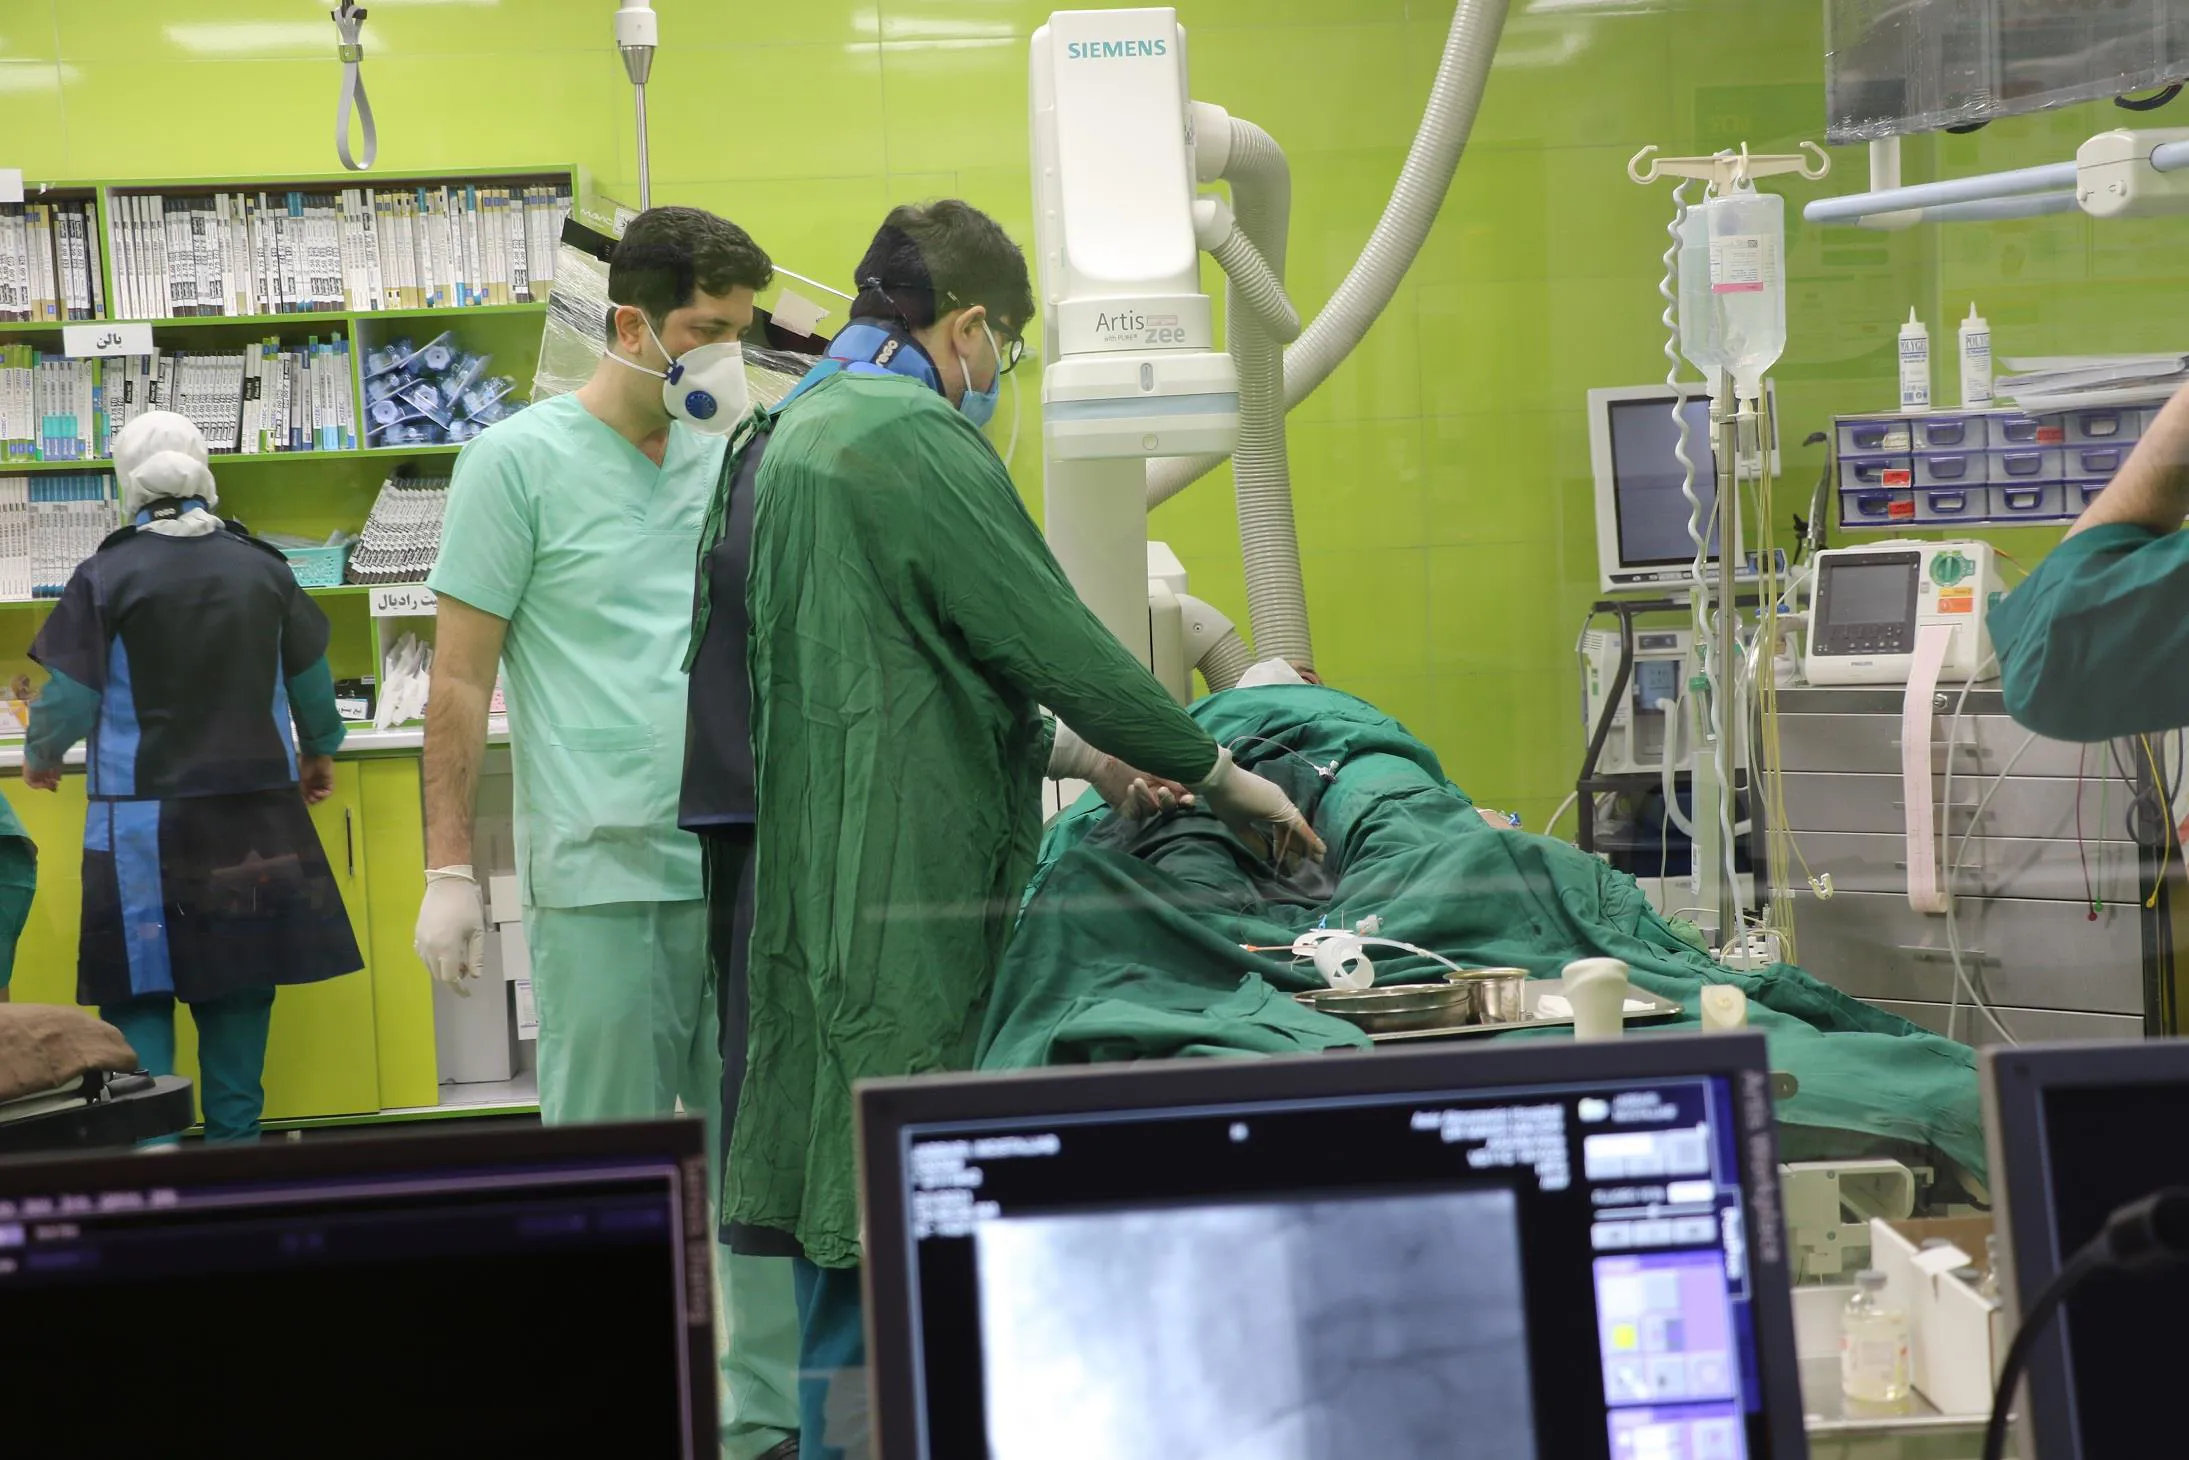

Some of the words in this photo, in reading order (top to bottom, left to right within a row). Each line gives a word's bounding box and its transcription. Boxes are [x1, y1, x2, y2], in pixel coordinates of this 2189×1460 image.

[1068, 40, 1167, 59] SIEMENS
[1095, 310, 1145, 332] Artis
[96, 332, 122, 349] بالن
[1145, 327, 1185, 344] zee
[378, 594, 417, 610] رادیال
